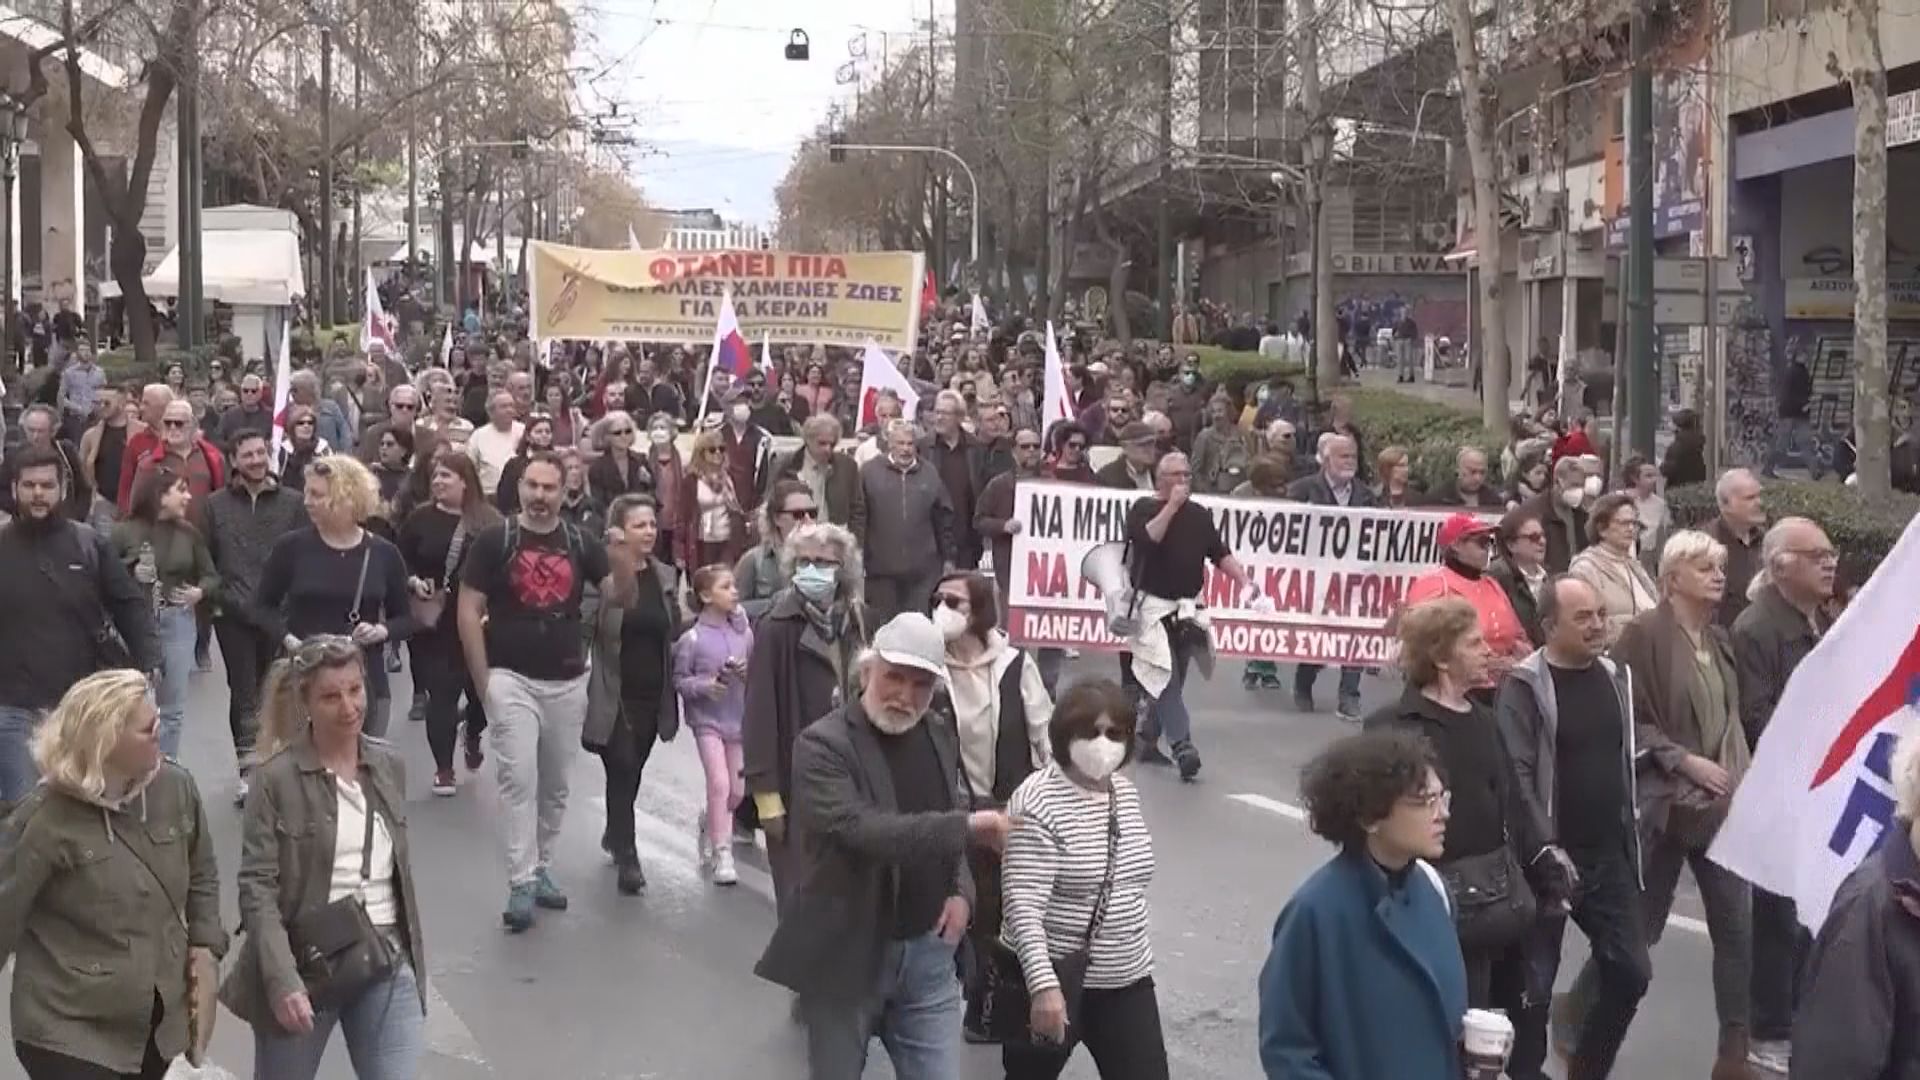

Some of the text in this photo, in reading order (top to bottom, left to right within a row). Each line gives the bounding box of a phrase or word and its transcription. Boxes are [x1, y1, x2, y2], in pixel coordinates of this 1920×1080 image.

[649, 252, 847, 281] ΦΤΑΝΕΙ ΠΙΑ
[732, 280, 839, 299] ΧΑΜΕΝΕΣ
[845, 283, 903, 303] ΖΩΕΣ
[680, 300, 714, 316] ΓΙΑ
[755, 300, 828, 318] ΚΕΡΔΗ
[611, 325, 715, 337] ΠΑΝΕΛΛΗΝΙΟ
[1029, 493, 1063, 539] ΝΑ
[1073, 496, 1130, 542] ΜΗΝ
[1208, 507, 1311, 556] ΛΥΦΘΕΙ
[1319, 516, 1351, 559] ΤΟ
[1026, 551, 1068, 598] ΝΑ
[1265, 567, 1315, 614] ΚΑΙ
[1321, 572, 1417, 618] ΑΓΩΝ
